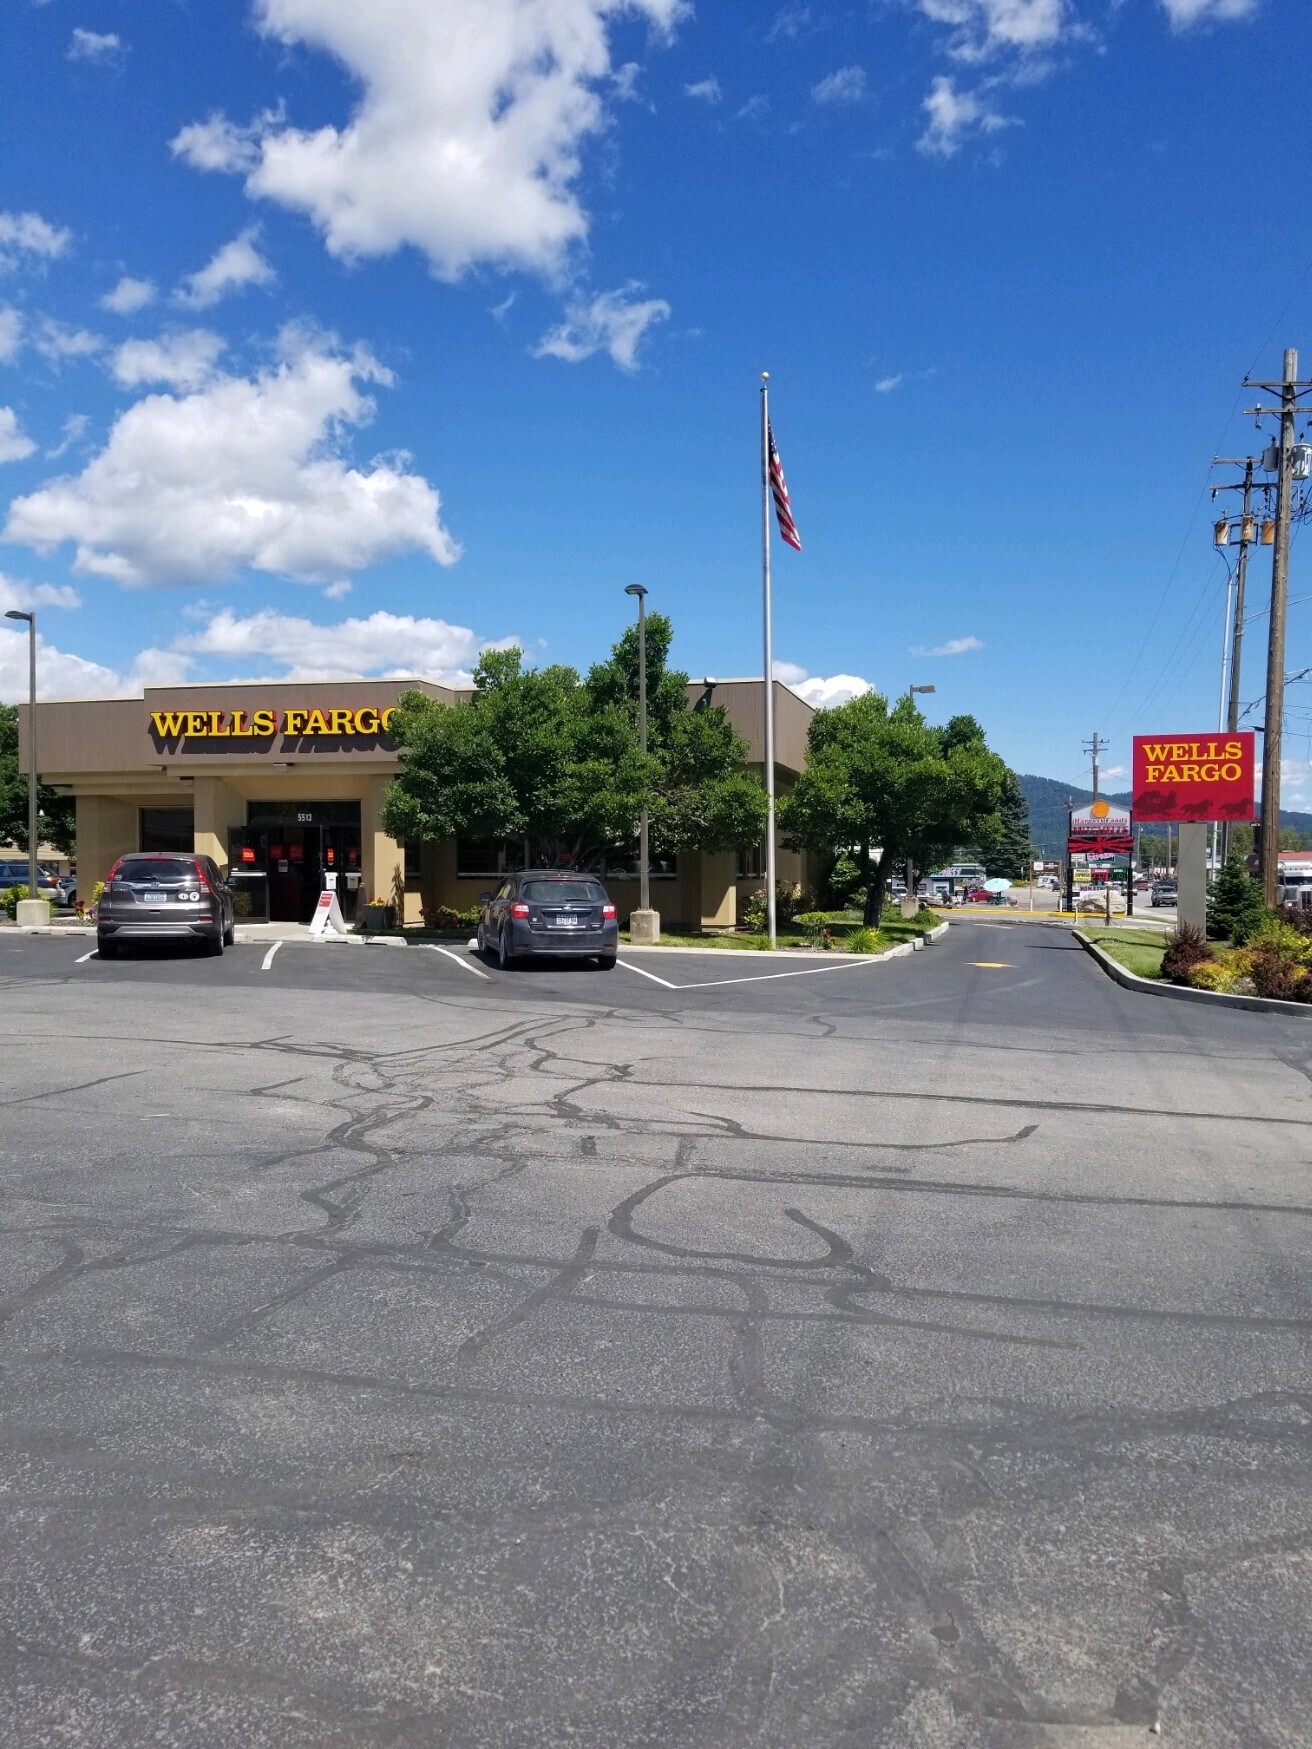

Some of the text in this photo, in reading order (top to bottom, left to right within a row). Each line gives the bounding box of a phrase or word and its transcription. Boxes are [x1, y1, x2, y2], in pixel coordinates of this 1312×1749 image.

[150, 709, 275, 737] WELLS
[1142, 741, 1243, 762] WELLS
[1145, 763, 1242, 783] FARGO
[297, 813, 313, 822] 5513
